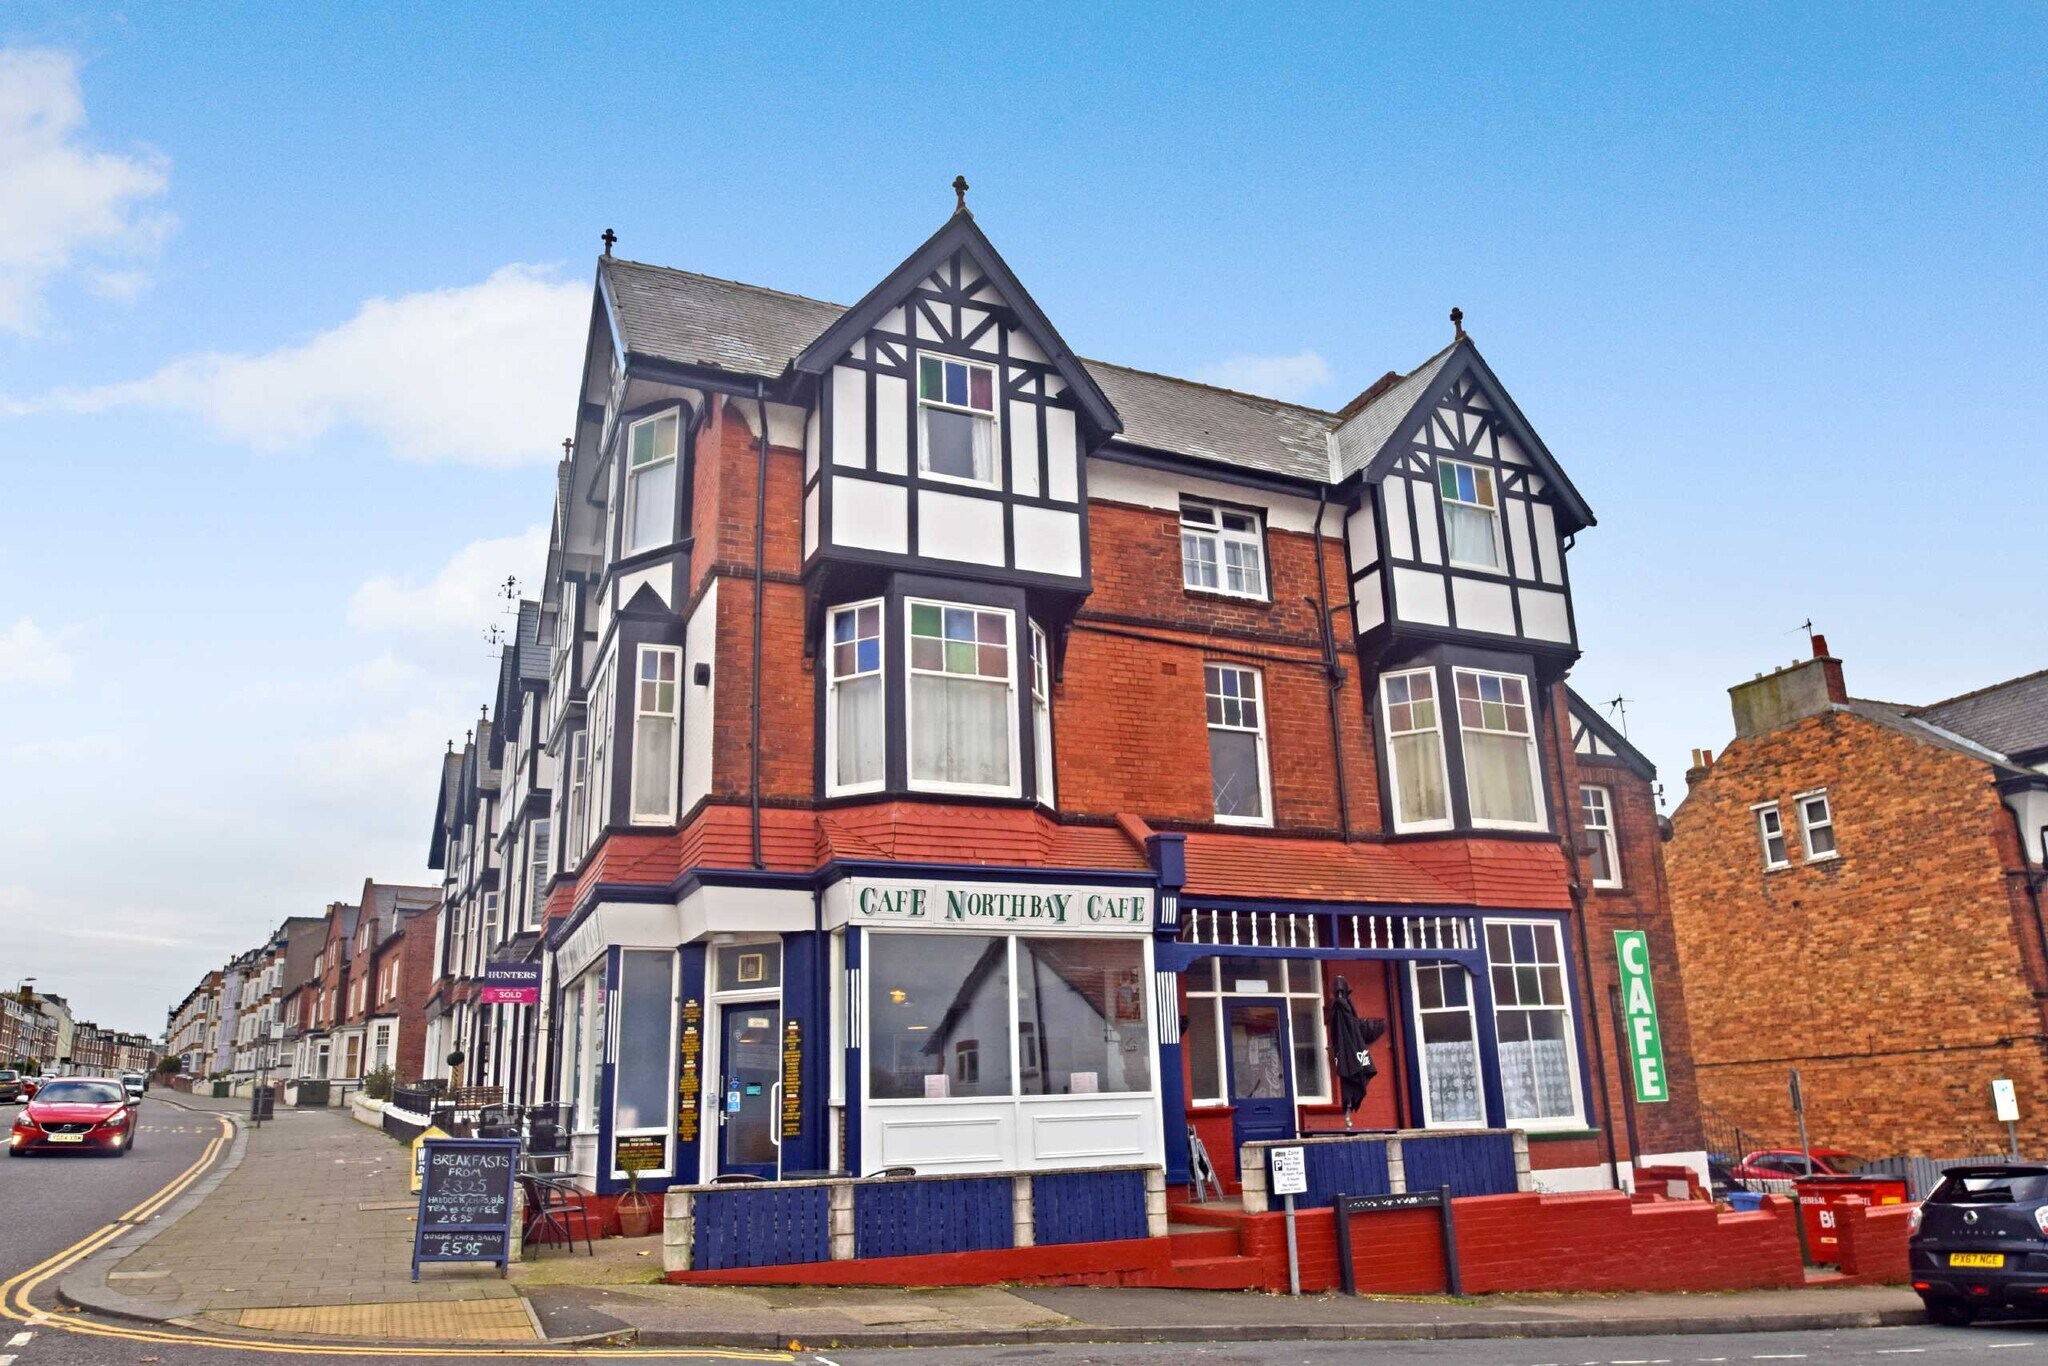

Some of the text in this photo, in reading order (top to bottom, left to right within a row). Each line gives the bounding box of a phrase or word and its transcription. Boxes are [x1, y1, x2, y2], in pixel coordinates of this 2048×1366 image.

[859, 887, 926, 917] CAFE
[1086, 894, 1145, 923] CAFE
[488, 971, 538, 980] HUNTERS
[499, 991, 522, 999] SOLD
[1622, 937, 1661, 1097] CAFE
[432, 1153, 510, 1168] BREAKFASTS
[448, 1167, 482, 1177] FROM
[1799, 1196, 1827, 1205] GENERAL
[427, 1205, 447, 1213] TEA
[461, 1205, 499, 1214] COFFEE
[1953, 1254, 1999, 1265] PX67 NGE
